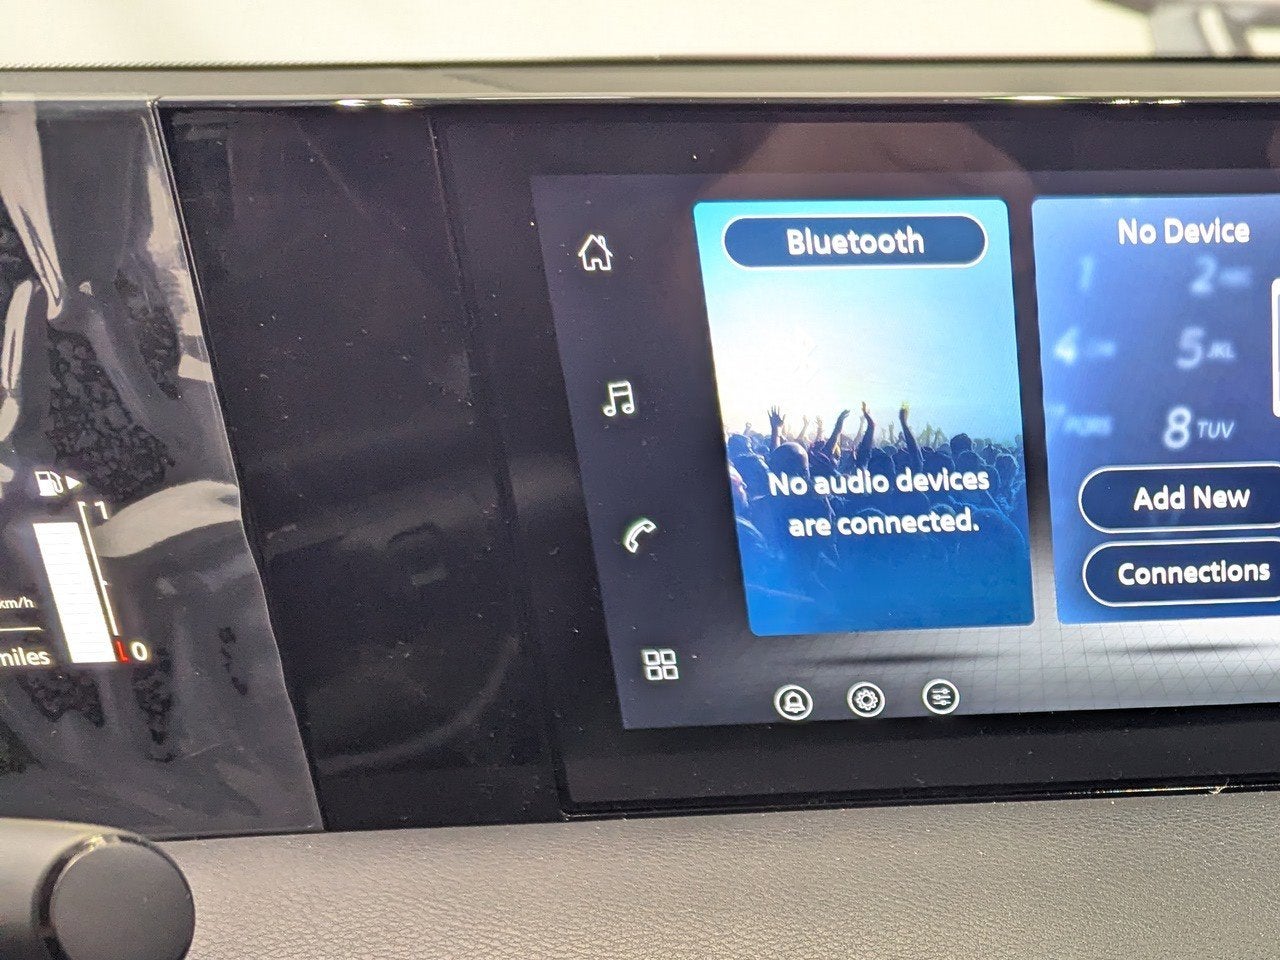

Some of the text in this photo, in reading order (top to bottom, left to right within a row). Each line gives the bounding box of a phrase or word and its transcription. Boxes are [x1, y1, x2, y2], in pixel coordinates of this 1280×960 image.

[786, 225, 925, 256] Bluetooth
[1118, 216, 1250, 245] No Device
[1163, 405, 1236, 450] 8 TUV
[768, 466, 990, 497] No audio devices
[1133, 484, 1251, 511] Add New
[788, 507, 980, 537] are connected.
[1118, 560, 1271, 587] Connections
